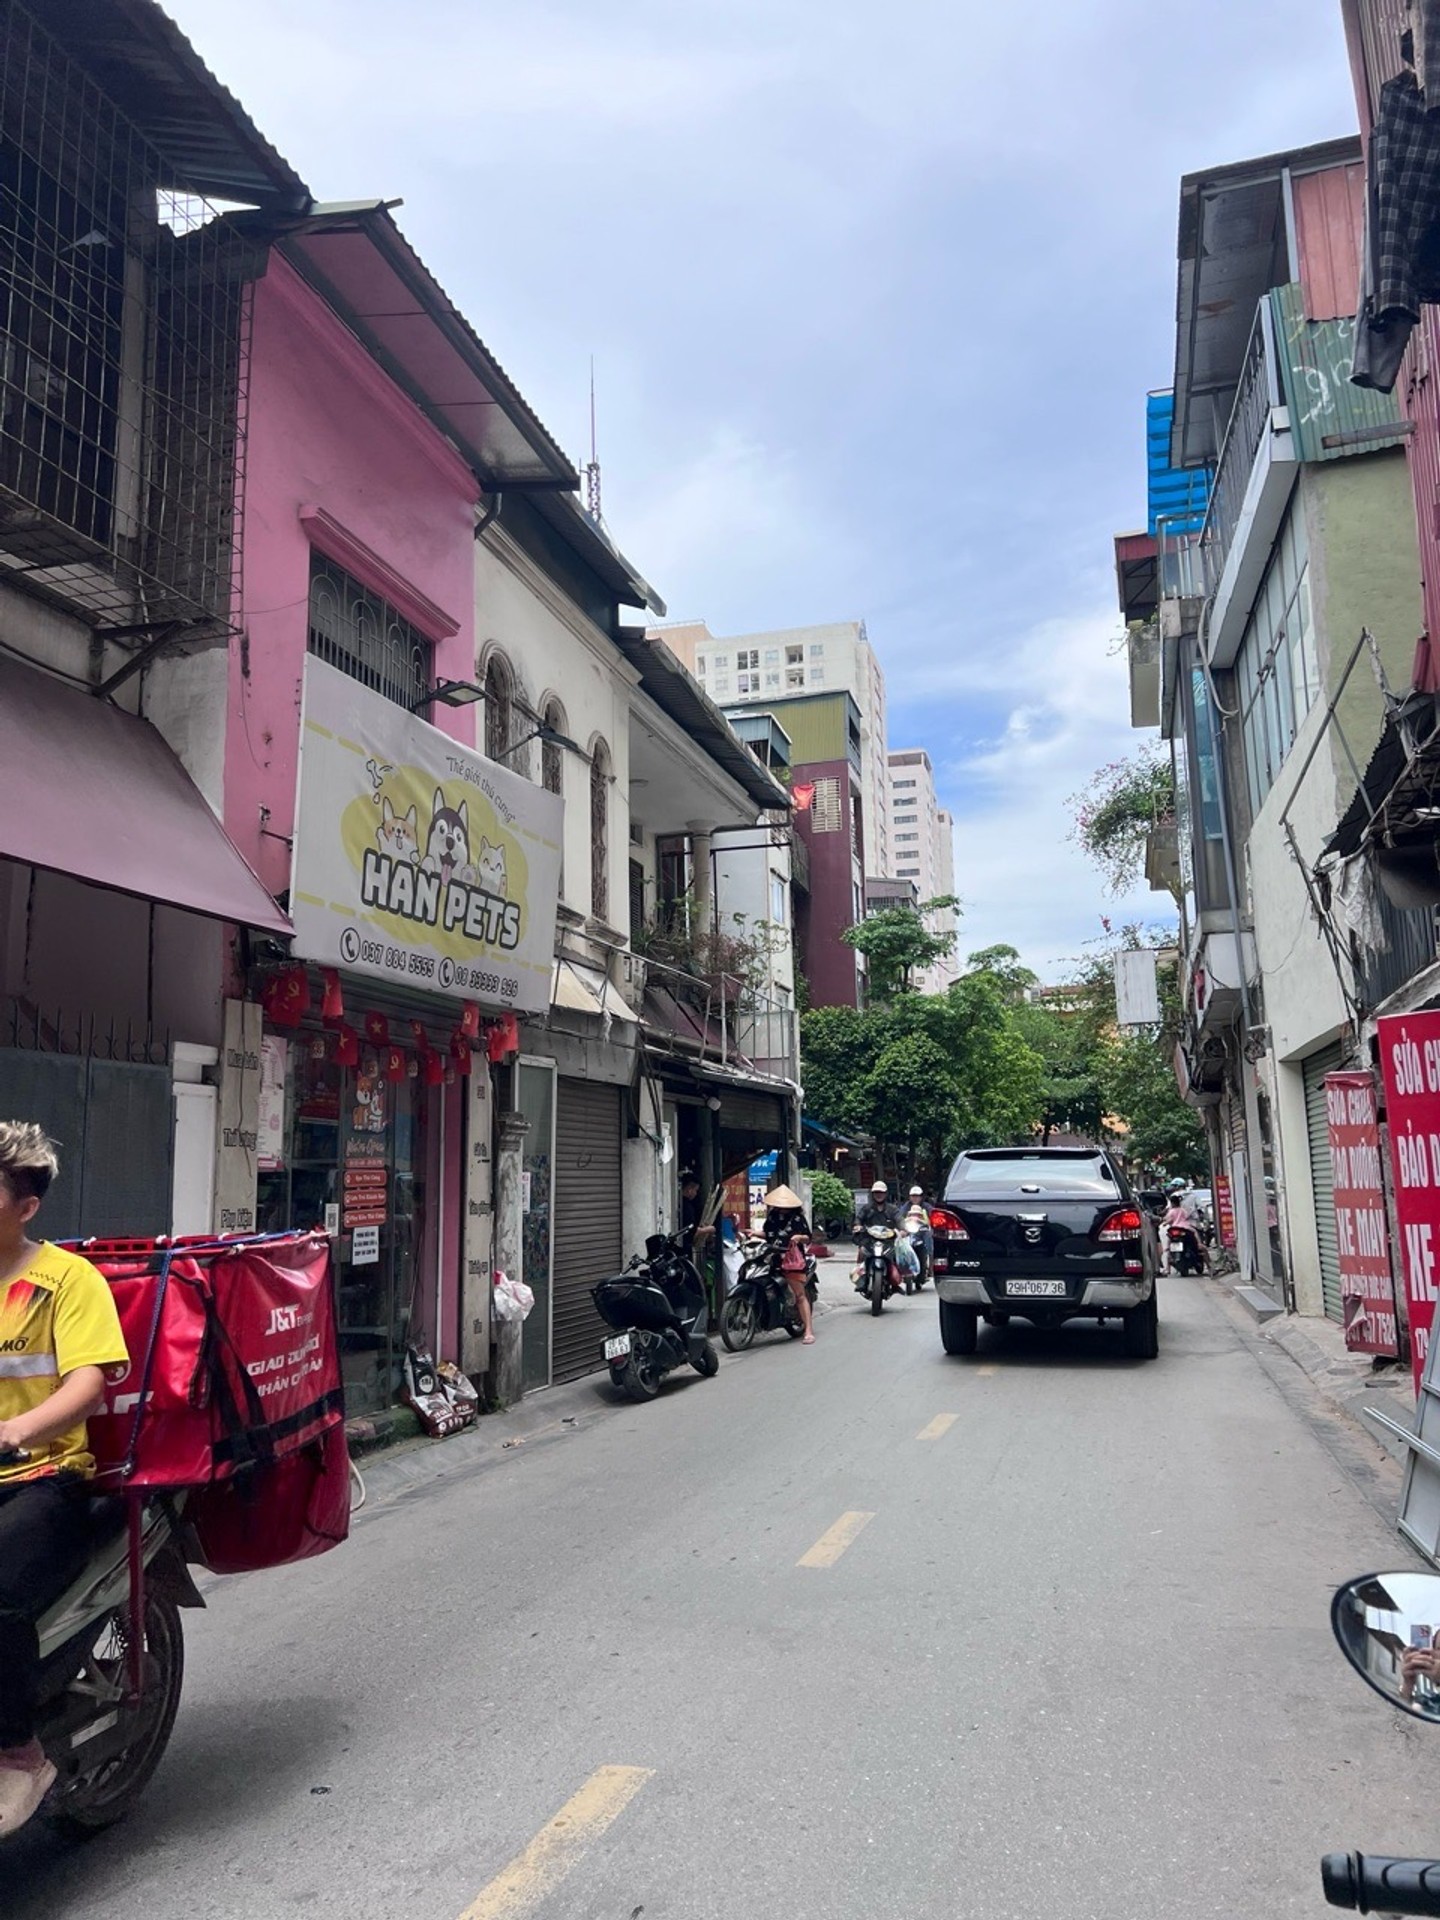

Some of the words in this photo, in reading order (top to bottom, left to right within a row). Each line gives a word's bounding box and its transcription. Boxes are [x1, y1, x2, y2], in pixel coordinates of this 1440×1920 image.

[361, 848, 442, 926] HAN
[443, 878, 521, 950] PETS
[409, 953, 435, 978] 5555
[1392, 1027, 1424, 1096] SỬA
[1397, 1118, 1428, 1188] BẢO
[1337, 1208, 1355, 1256] XE
[1355, 1198, 1386, 1257] MÁY
[1405, 1223, 1438, 1302] XE
[264, 1303, 301, 1336] J&T
[246, 1355, 285, 1376] GIAO
